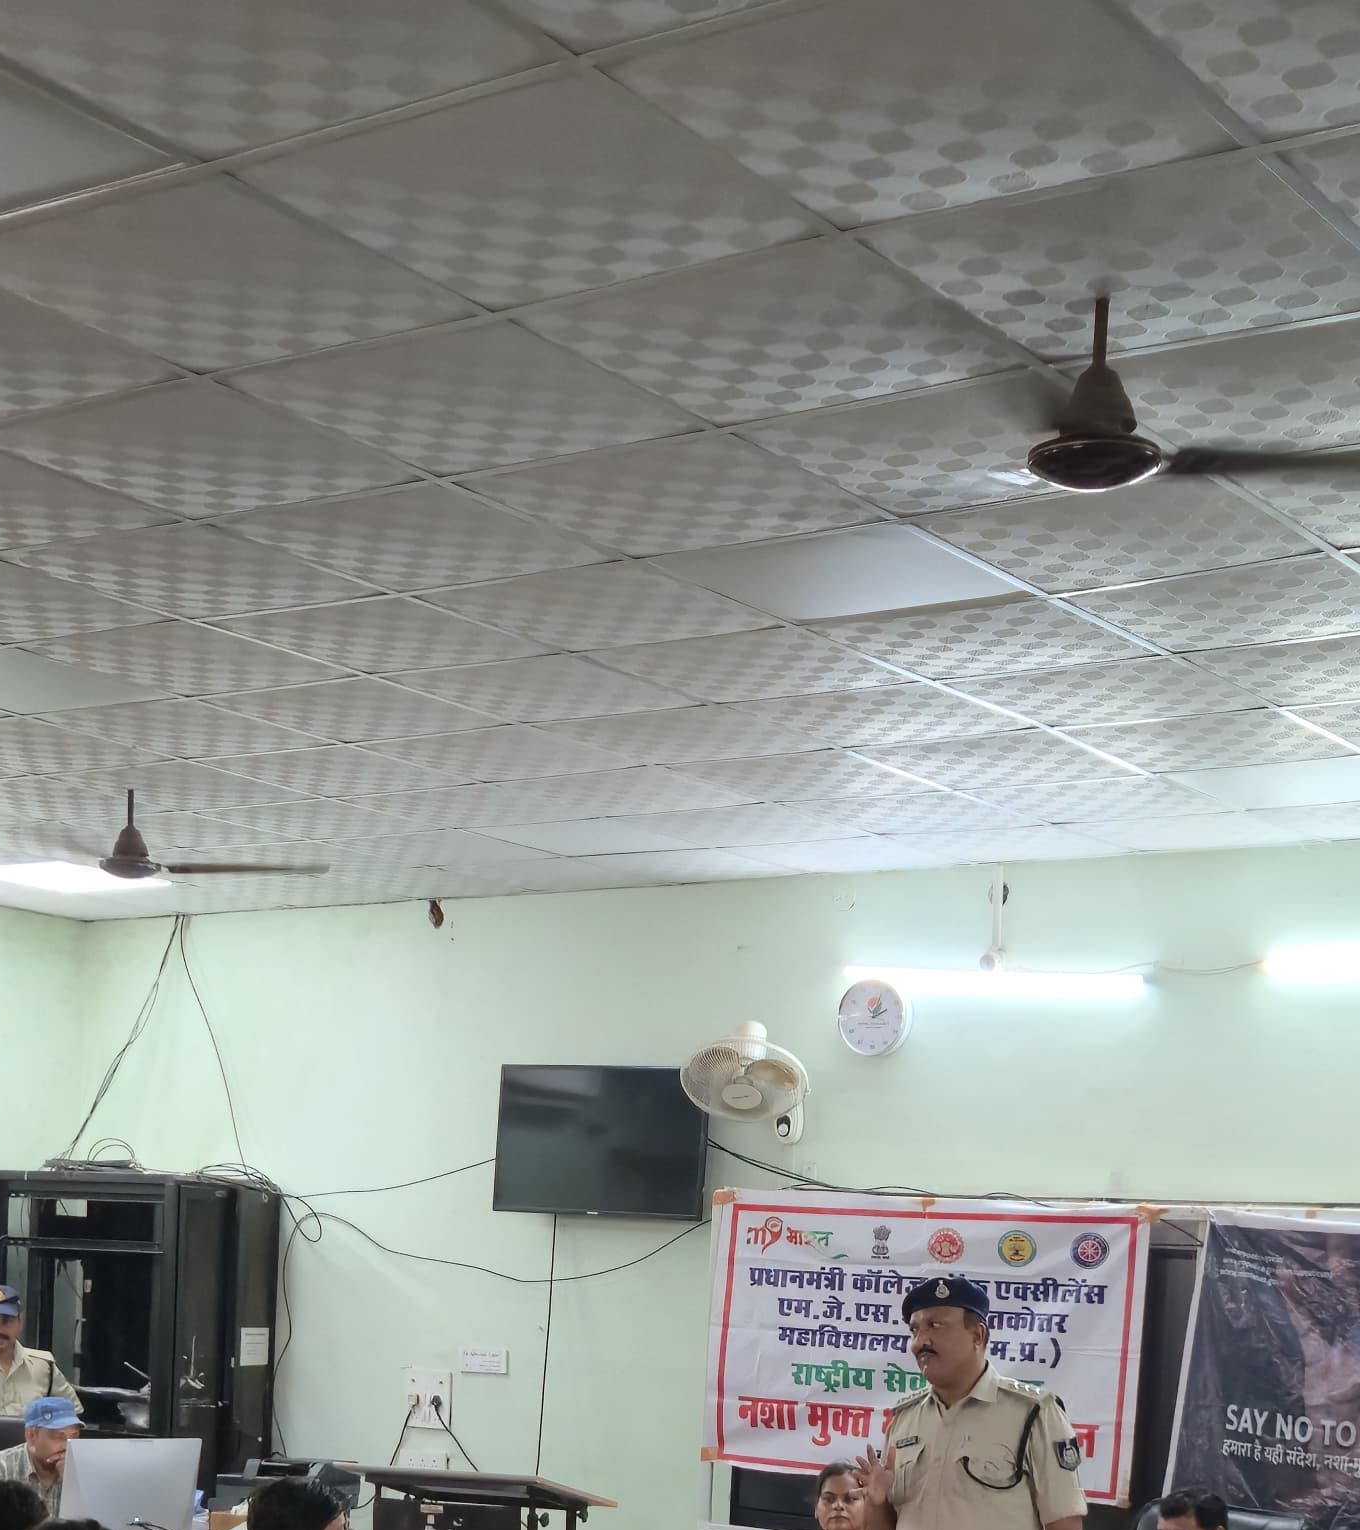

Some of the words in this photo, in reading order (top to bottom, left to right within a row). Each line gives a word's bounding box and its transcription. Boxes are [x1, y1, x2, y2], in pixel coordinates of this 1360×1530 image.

[749, 1267, 846, 1291] प्रधानमंत्री
[778, 1324, 911, 1353] महाविद्यालय
[990, 1338, 1061, 1368] म.प्र.)
[791, 1360, 876, 1392] राष्ट्रीय
[882, 1362, 928, 1393] सेव
[738, 1396, 798, 1430] नशा
[805, 1402, 874, 1446] मुक्त
[1225, 1404, 1269, 1436] SAY
[1275, 1412, 1314, 1443] NO
[1321, 1419, 1357, 1448] TO
[1223, 1439, 1252, 1457] हमारा
[1254, 1441, 1261, 1462] है
[1264, 1444, 1283, 1466] यही
